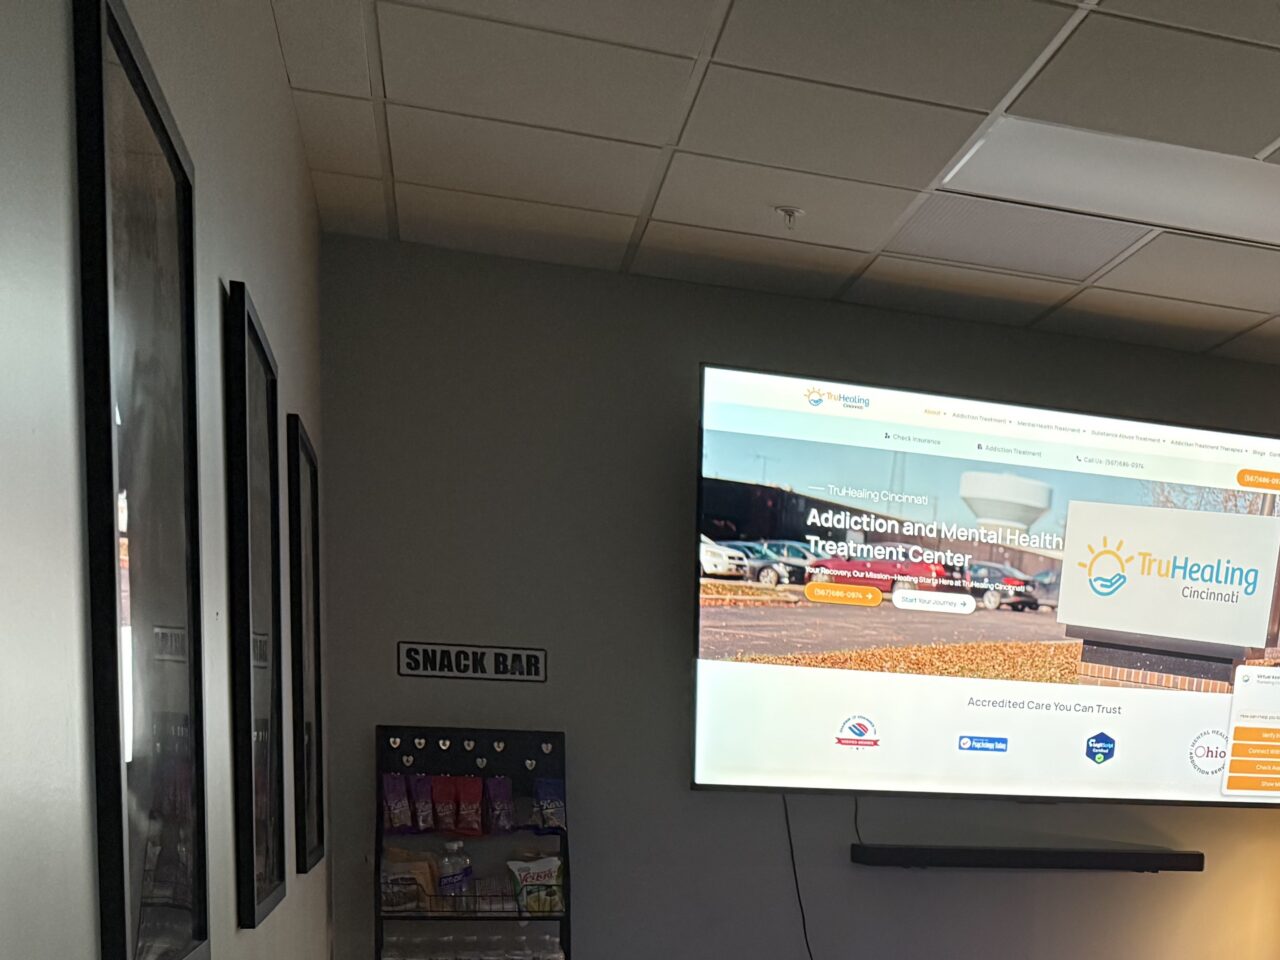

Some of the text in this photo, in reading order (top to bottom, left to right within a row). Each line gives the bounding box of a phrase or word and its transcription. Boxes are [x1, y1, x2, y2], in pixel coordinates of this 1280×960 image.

[827, 392, 870, 408] TruHealing
[893, 434, 941, 446] Check Insurance
[985, 445, 1042, 458] Addiction Treatment
[828, 484, 929, 506] TruHealing Cincinnati
[806, 509, 1064, 551] Addiction and Mental Health
[805, 535, 973, 567] Treatment Center
[805, 566, 820, 574] Your
[852, 570, 865, 578] Our
[918, 576, 938, 585] Starts
[939, 578, 953, 586] Here
[1137, 552, 1259, 596] TruHealing
[901, 596, 957, 607] Start Your Journey
[1181, 586, 1240, 604] Cincinnati
[405, 647, 540, 676] SNACK BAR
[967, 696, 1122, 715] Accredited Care You Can Trust
[1194, 745, 1227, 759] Ohio
[1248, 747, 1270, 755] Connect
